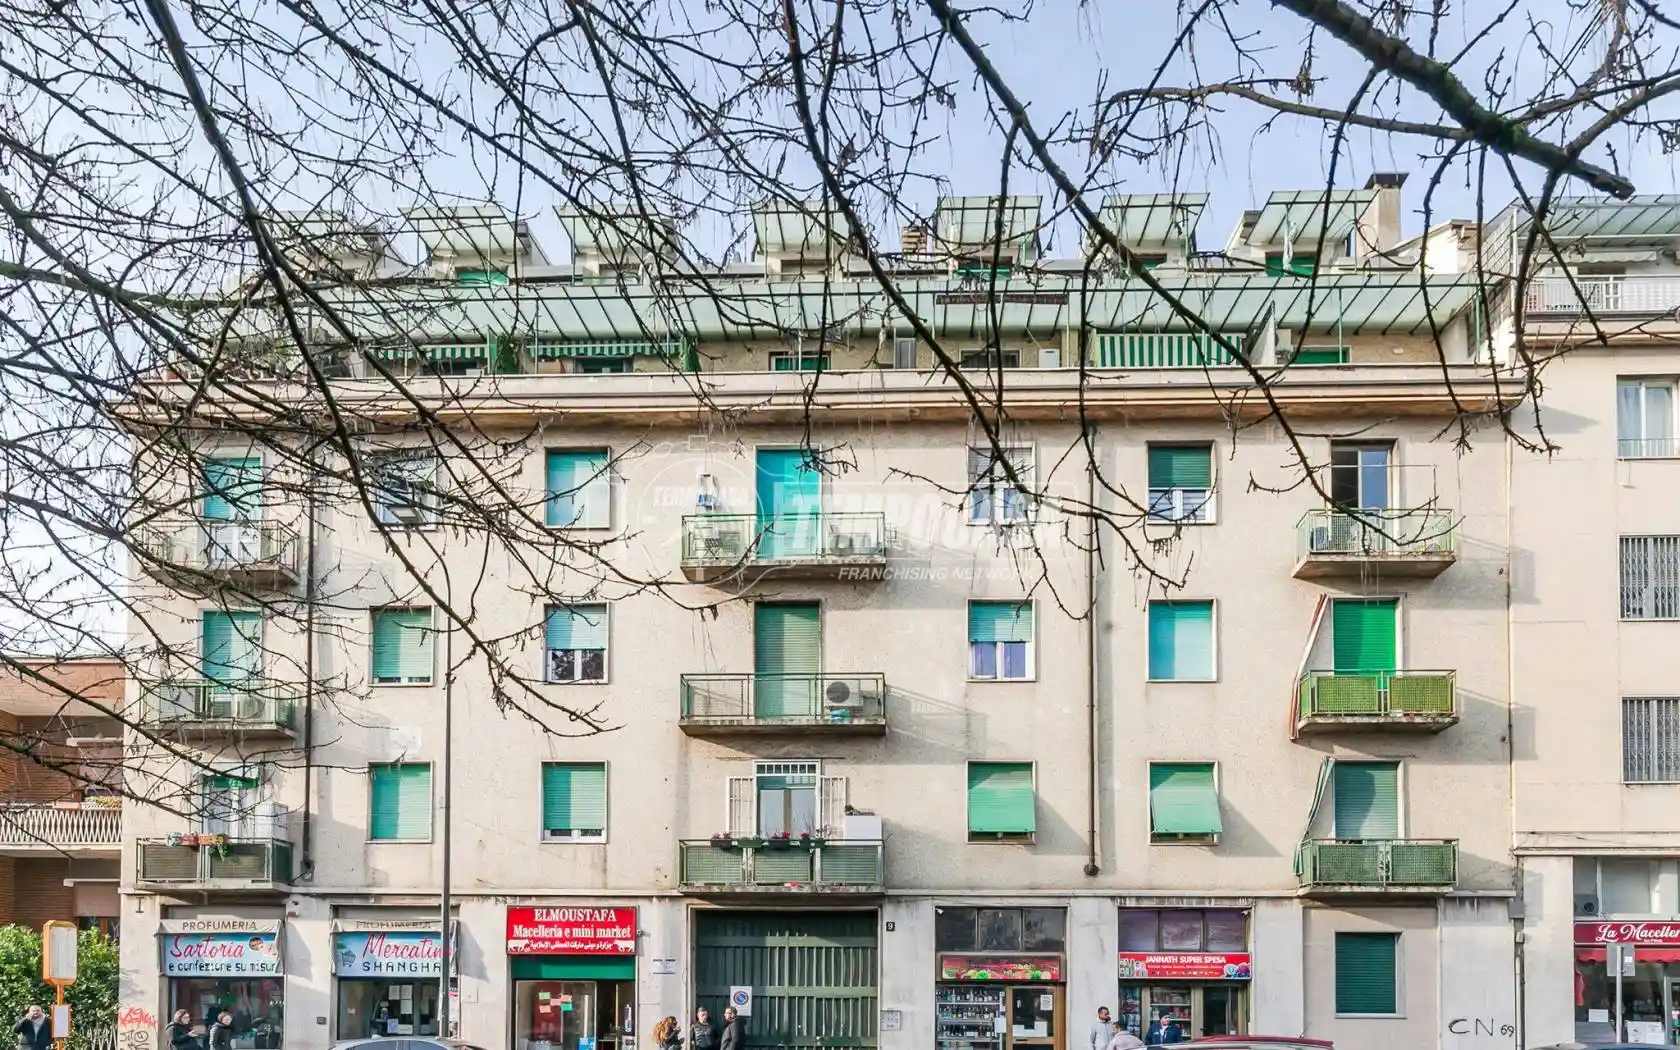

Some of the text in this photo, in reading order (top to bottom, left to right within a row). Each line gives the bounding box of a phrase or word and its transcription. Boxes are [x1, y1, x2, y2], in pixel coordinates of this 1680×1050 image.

[534, 908, 617, 922] ELMOUSTAFA
[182, 920, 258, 931] PROFUMERIA
[513, 924, 632, 938] Macelleria e mini market
[1595, 924, 1619, 943] La
[170, 932, 246, 958] Sartoria
[362, 932, 452, 959] Mercatin
[168, 962, 175, 972] e
[177, 960, 232, 972] confezione
[235, 962, 246, 972] su
[1145, 955, 1227, 964] JANNATH SUPER SPESA
[1448, 1018, 1515, 1038] CN 69
